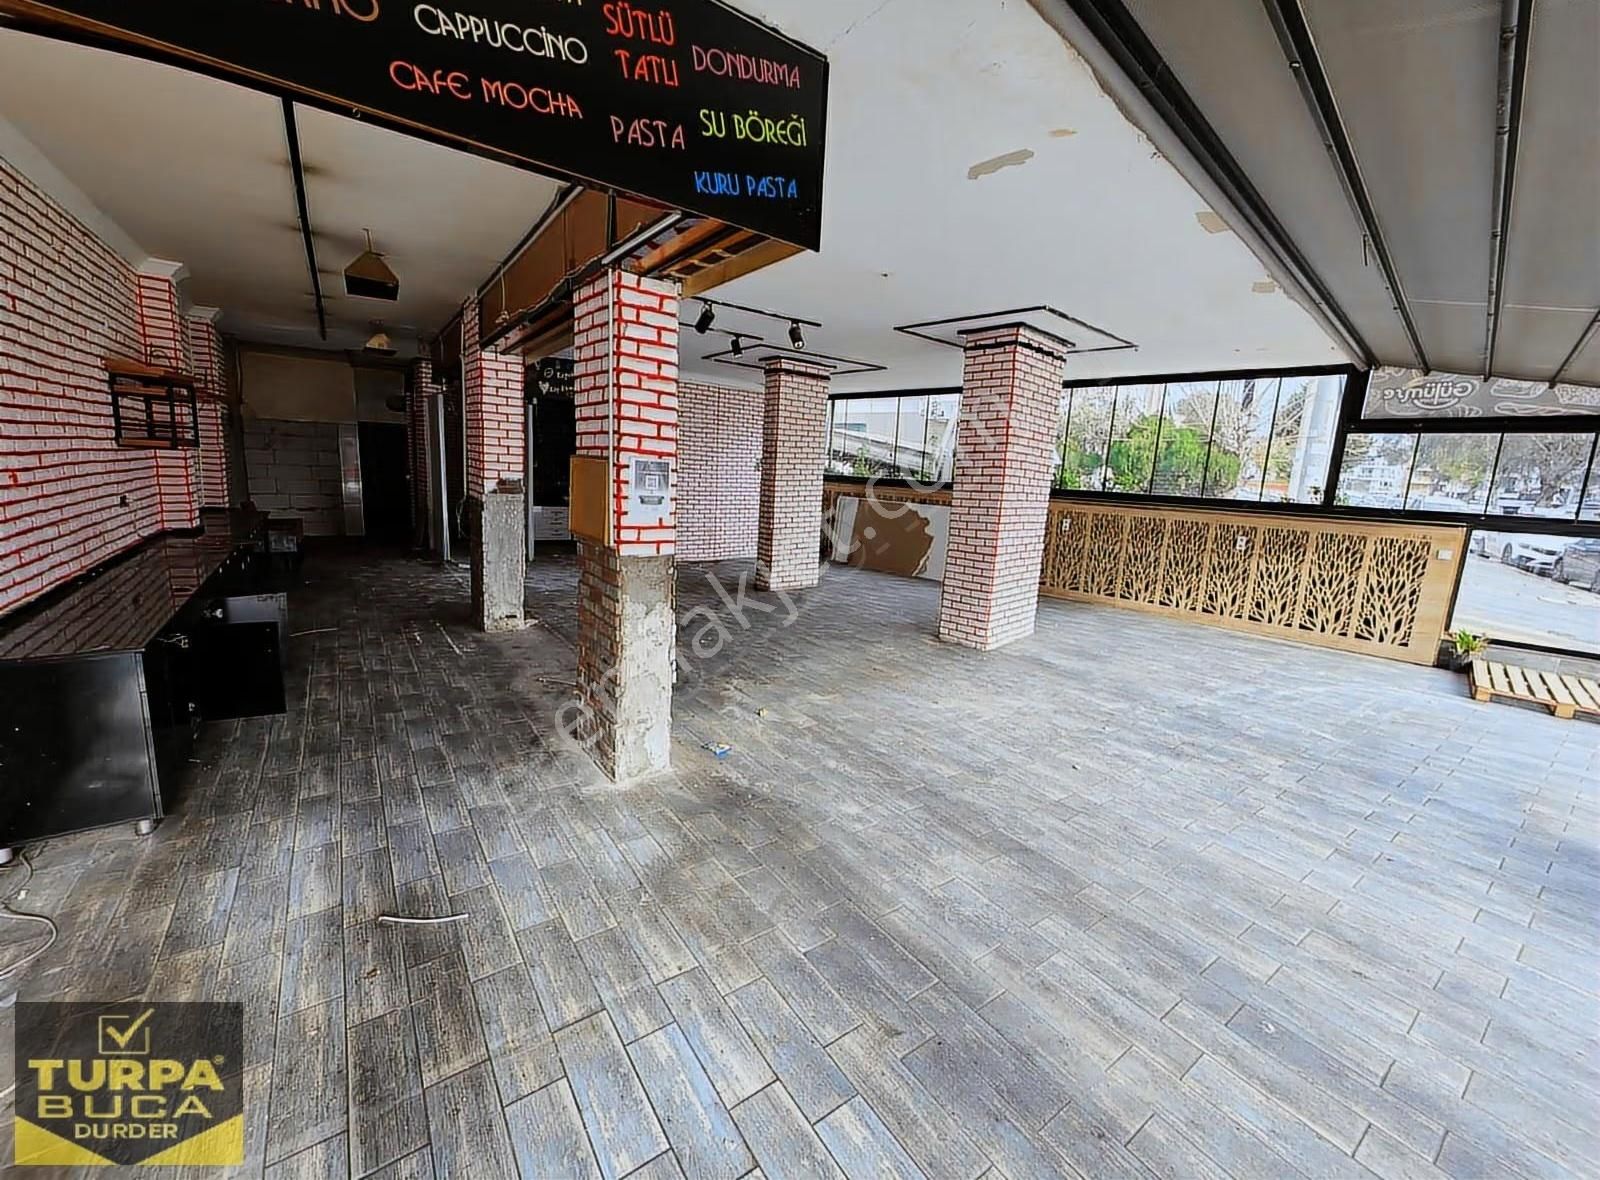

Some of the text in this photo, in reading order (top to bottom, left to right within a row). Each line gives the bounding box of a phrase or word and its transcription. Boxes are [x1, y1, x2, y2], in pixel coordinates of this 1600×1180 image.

[603, 1, 675, 47] SÜTLÜ
[614, 49, 679, 87] TATLI
[692, 44, 801, 89] DONDURMA
[389, 60, 584, 120] CAFE MOCHA
[609, 115, 685, 150] PASTA
[699, 109, 726, 138] SU
[694, 170, 798, 199] KURU PASTA
